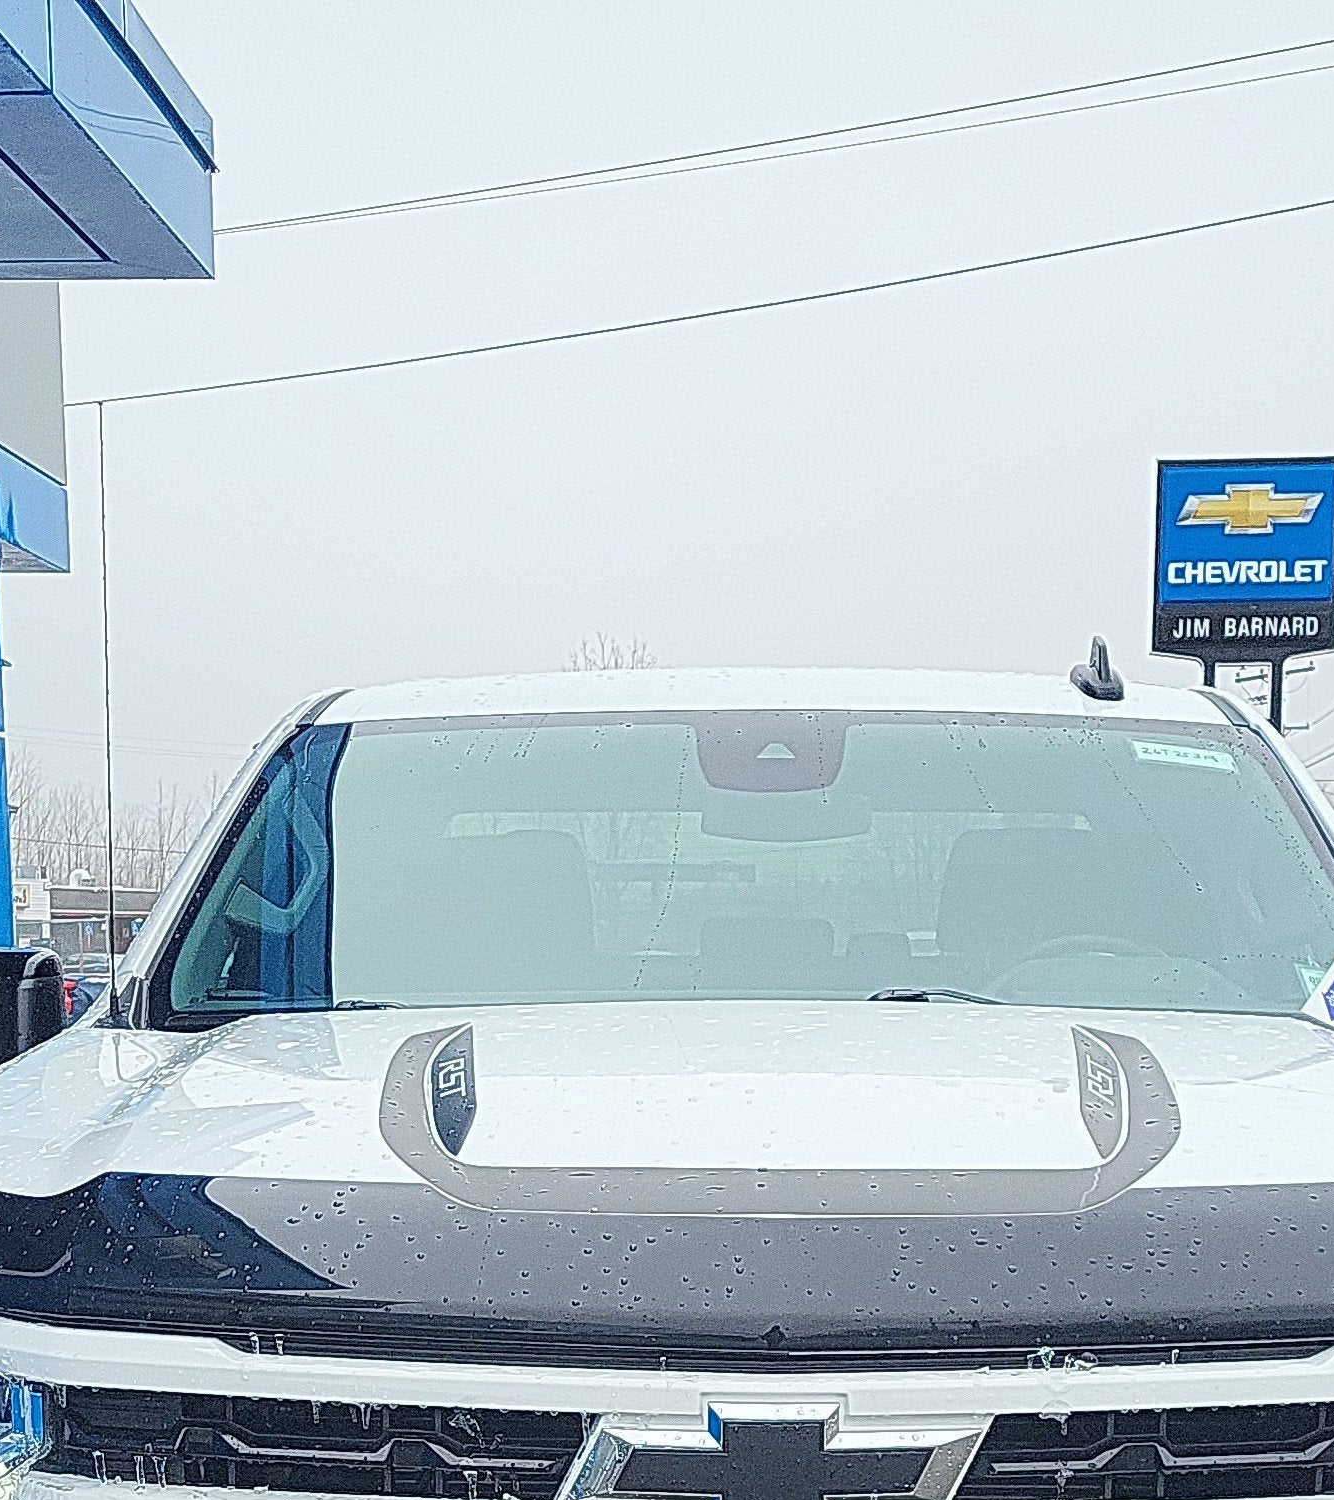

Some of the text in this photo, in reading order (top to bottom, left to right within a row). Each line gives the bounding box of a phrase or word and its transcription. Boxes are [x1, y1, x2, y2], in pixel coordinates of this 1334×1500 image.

[1167, 559, 1328, 585] CHEVROLET
[1172, 616, 1319, 639] JIM BARNARD
[438, 1057, 467, 1098] RST
[1086, 1054, 1115, 1107] RST
